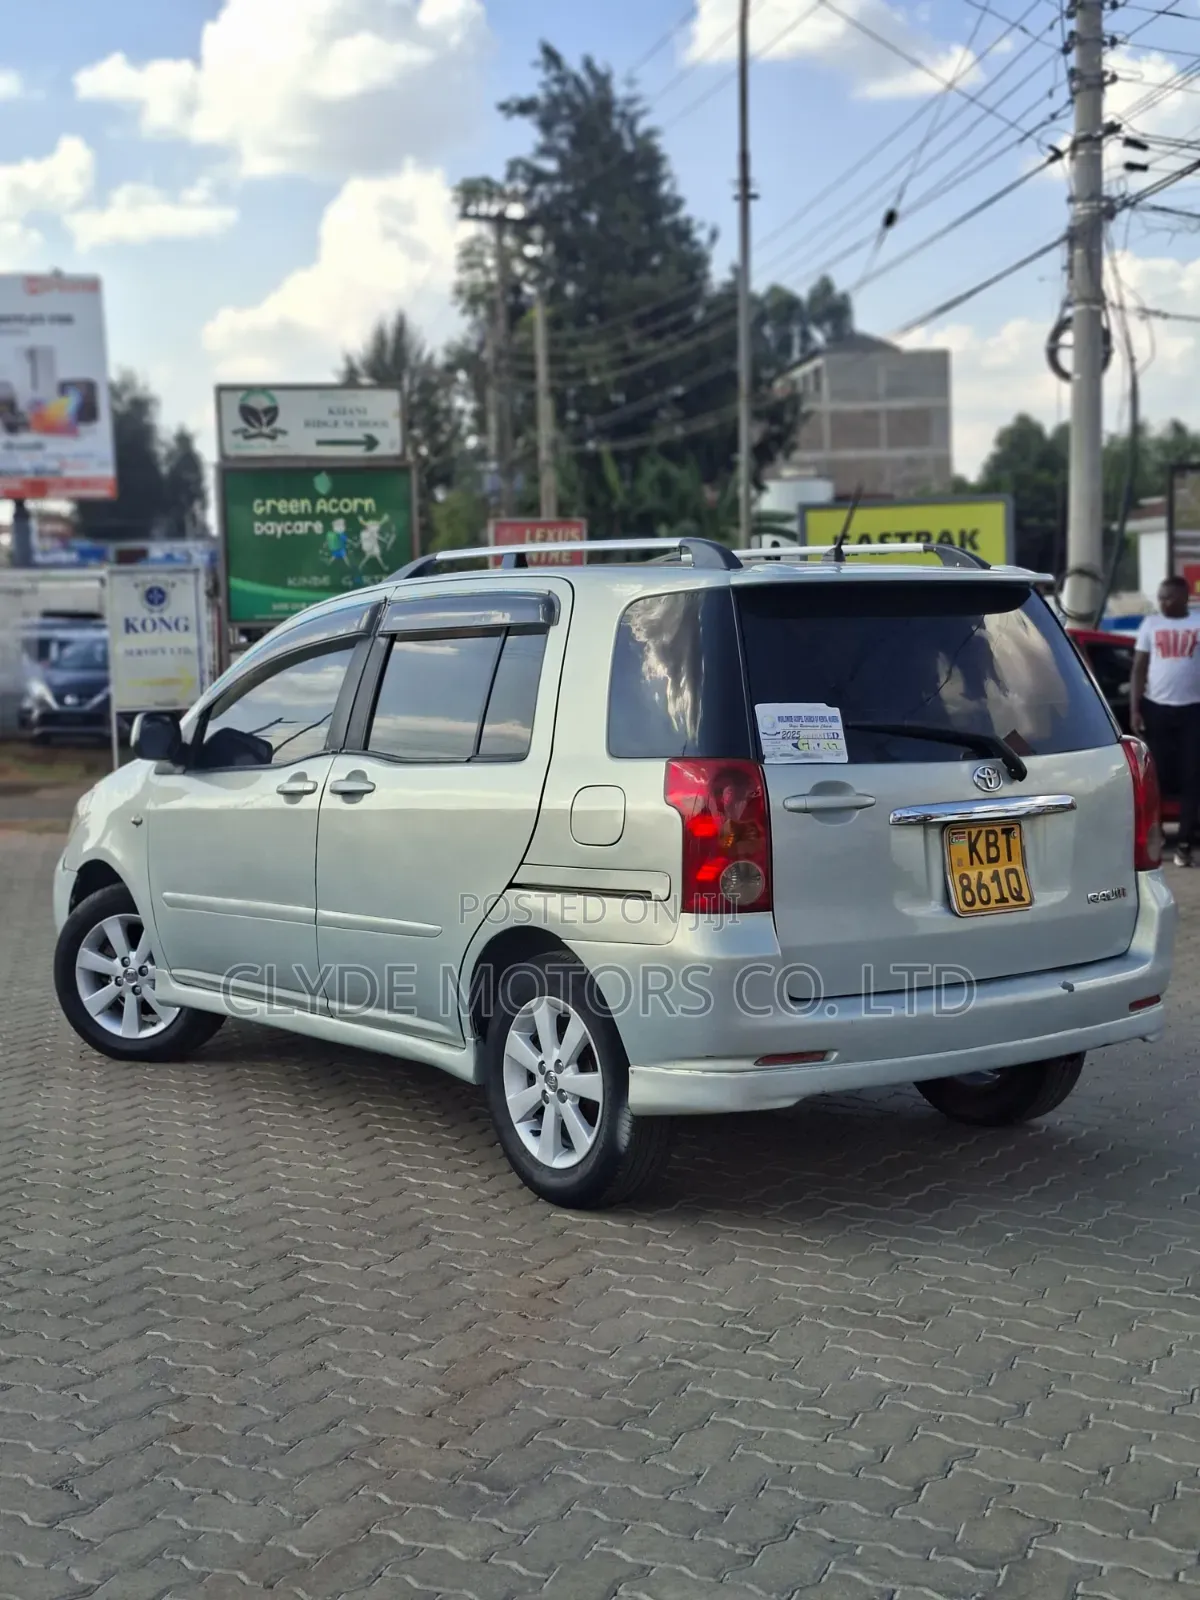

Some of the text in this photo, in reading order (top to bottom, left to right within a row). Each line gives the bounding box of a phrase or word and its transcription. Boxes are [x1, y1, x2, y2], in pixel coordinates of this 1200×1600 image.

[124, 616, 190, 635] KONG
[781, 730, 801, 739] 2025
[967, 828, 1015, 866] KBT
[958, 868, 1026, 908] 861Q
